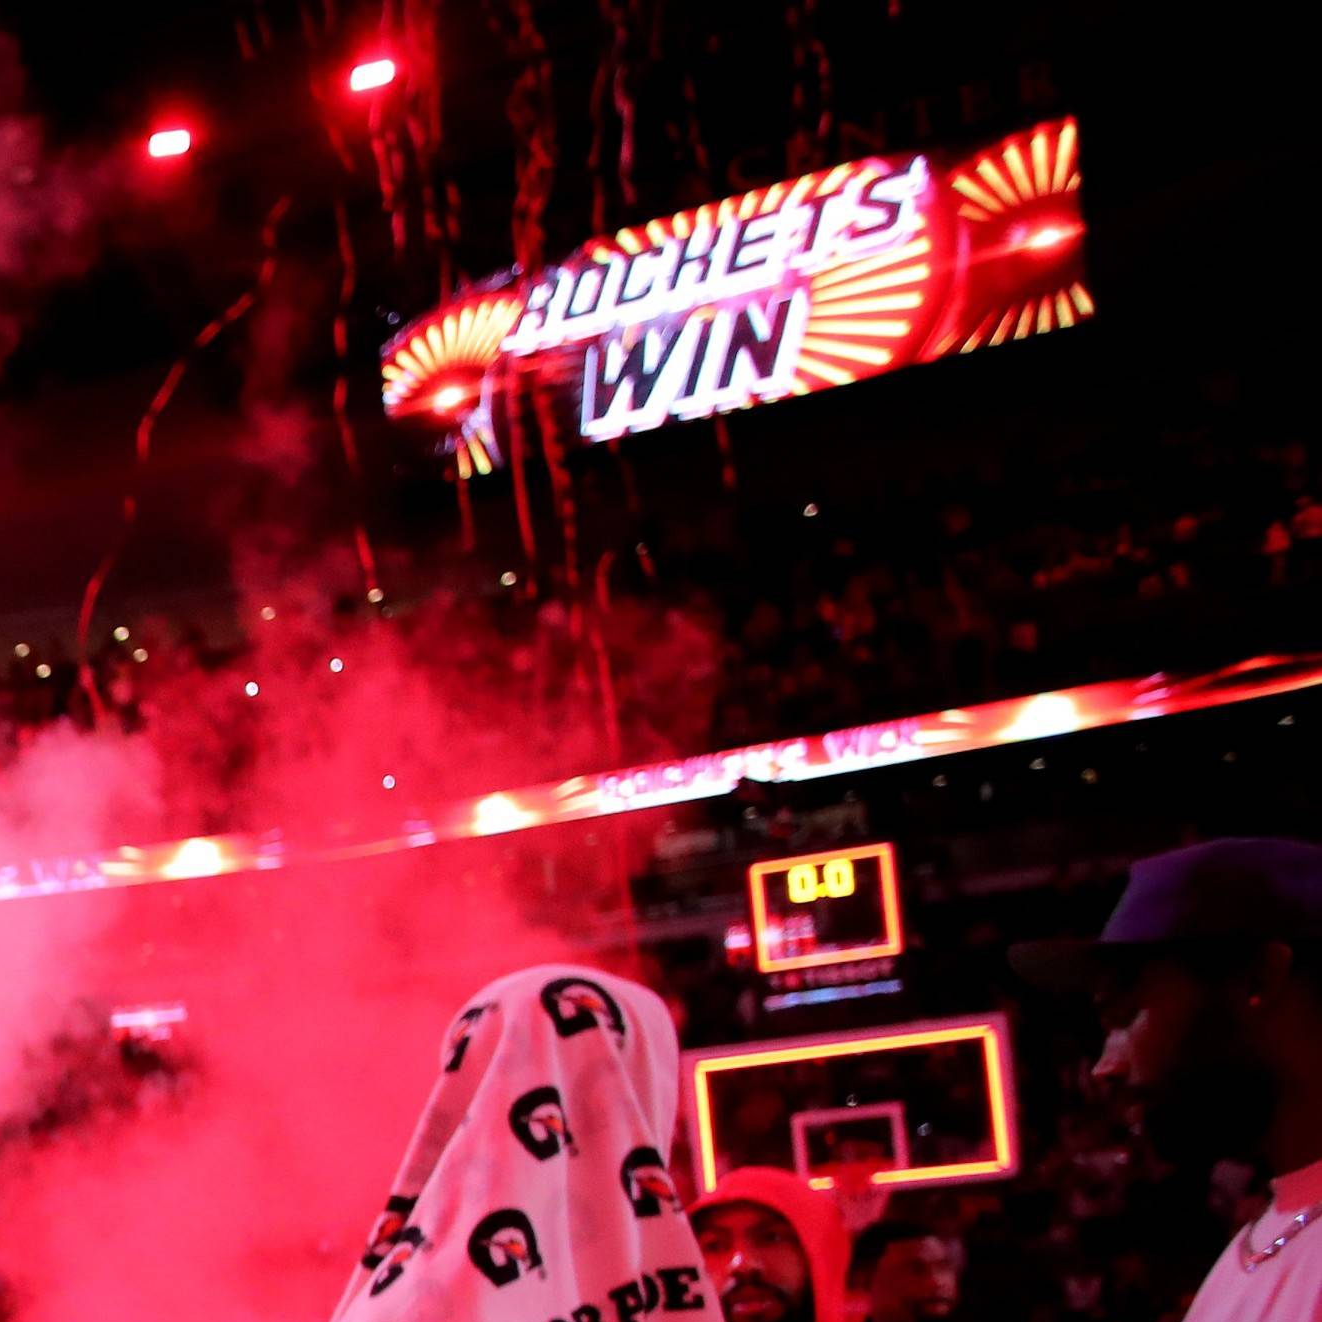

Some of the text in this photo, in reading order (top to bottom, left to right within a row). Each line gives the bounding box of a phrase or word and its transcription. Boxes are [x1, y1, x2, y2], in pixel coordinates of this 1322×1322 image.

[507, 155, 927, 350] ROCKETS
[581, 288, 809, 440] WIN
[787, 857, 856, 904] 0.0
